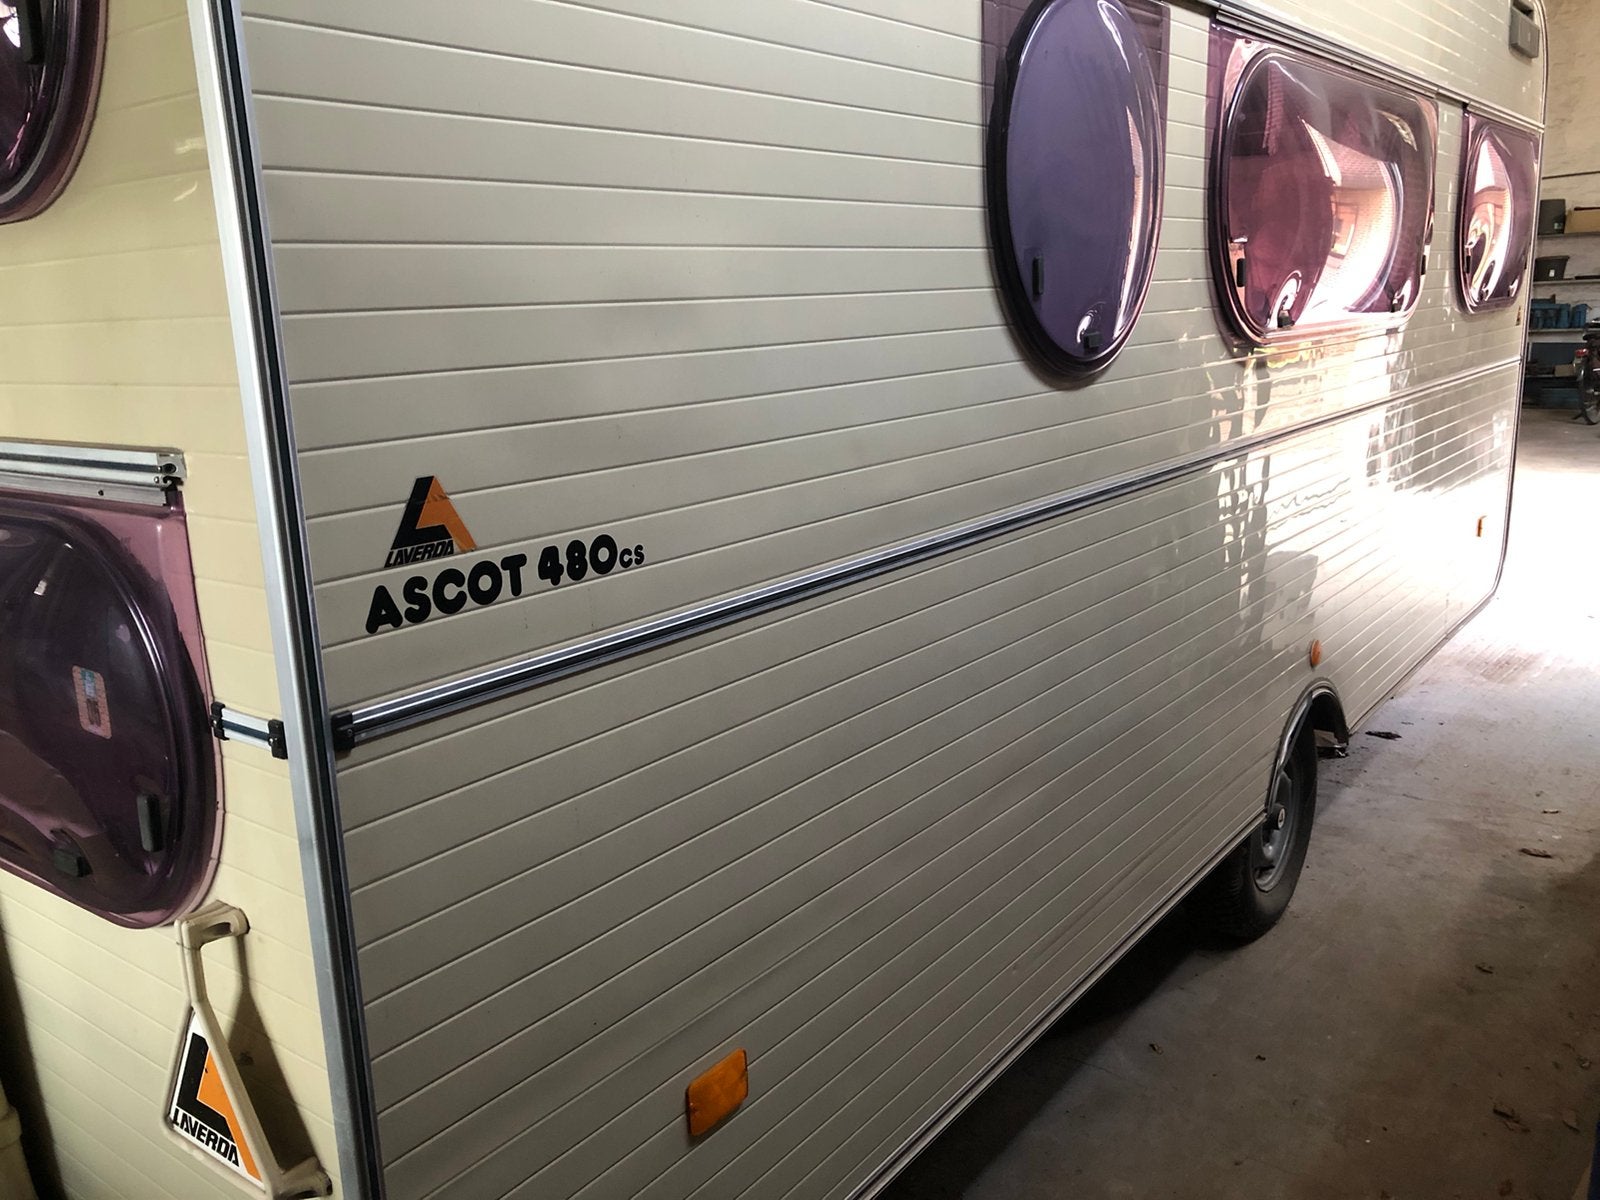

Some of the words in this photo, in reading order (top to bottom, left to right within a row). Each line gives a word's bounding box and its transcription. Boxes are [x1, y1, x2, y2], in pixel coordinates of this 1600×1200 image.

[383, 539, 455, 569] LAVERDA
[365, 553, 527, 634] ASCOT
[172, 1107, 240, 1167] LAVERDA
